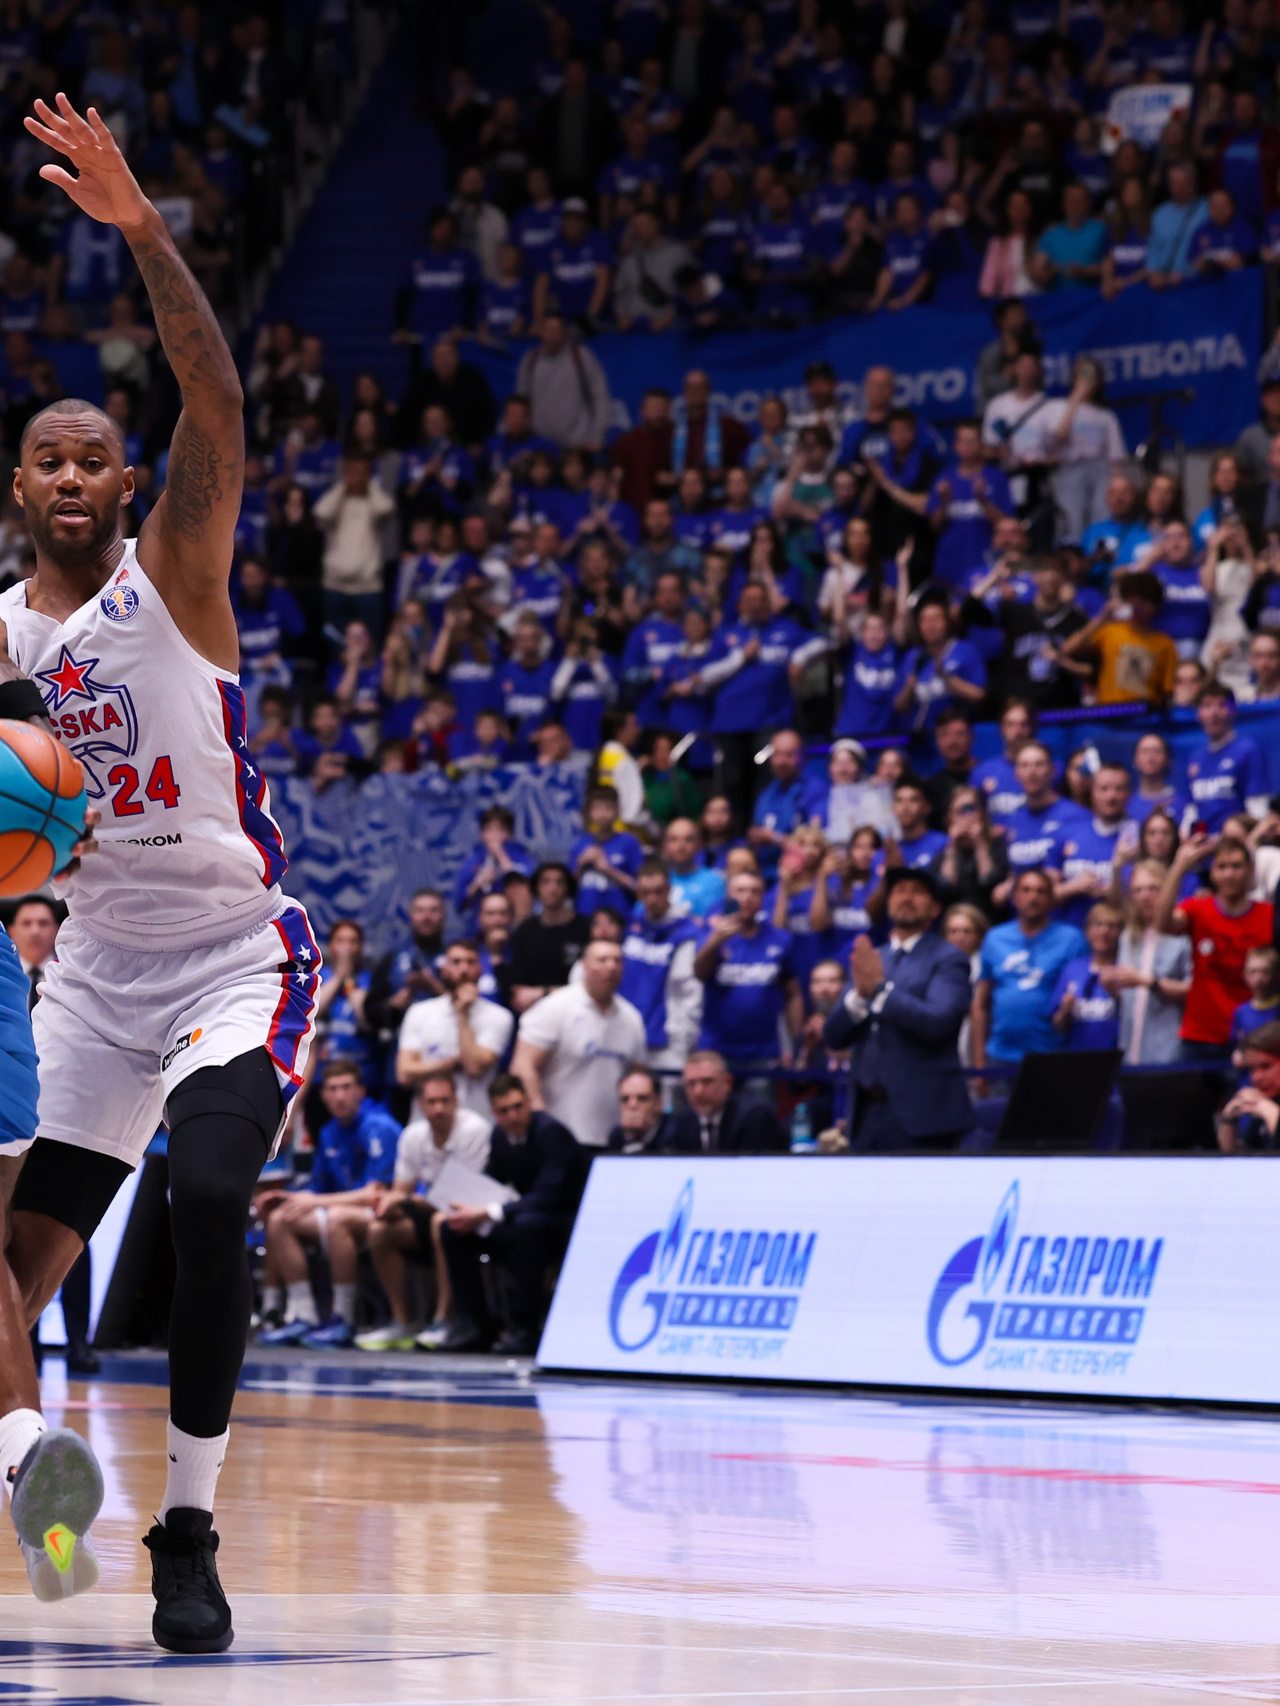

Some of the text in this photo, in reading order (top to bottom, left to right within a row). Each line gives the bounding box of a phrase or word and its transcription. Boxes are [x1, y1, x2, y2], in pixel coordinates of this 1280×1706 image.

[47, 702, 124, 742] CSKA
[107, 755, 181, 817] 24
[678, 1230, 818, 1288] ГАЗПРОМ
[1004, 1235, 1165, 1298] ГАЗПРОМ
[670, 1295, 799, 1328] ТРАНСГАЗ
[997, 1306, 1141, 1341] ТРАНСГАЗ
[984, 1347, 1134, 1376] САНКТ-ПЕТЕРБУРГ
